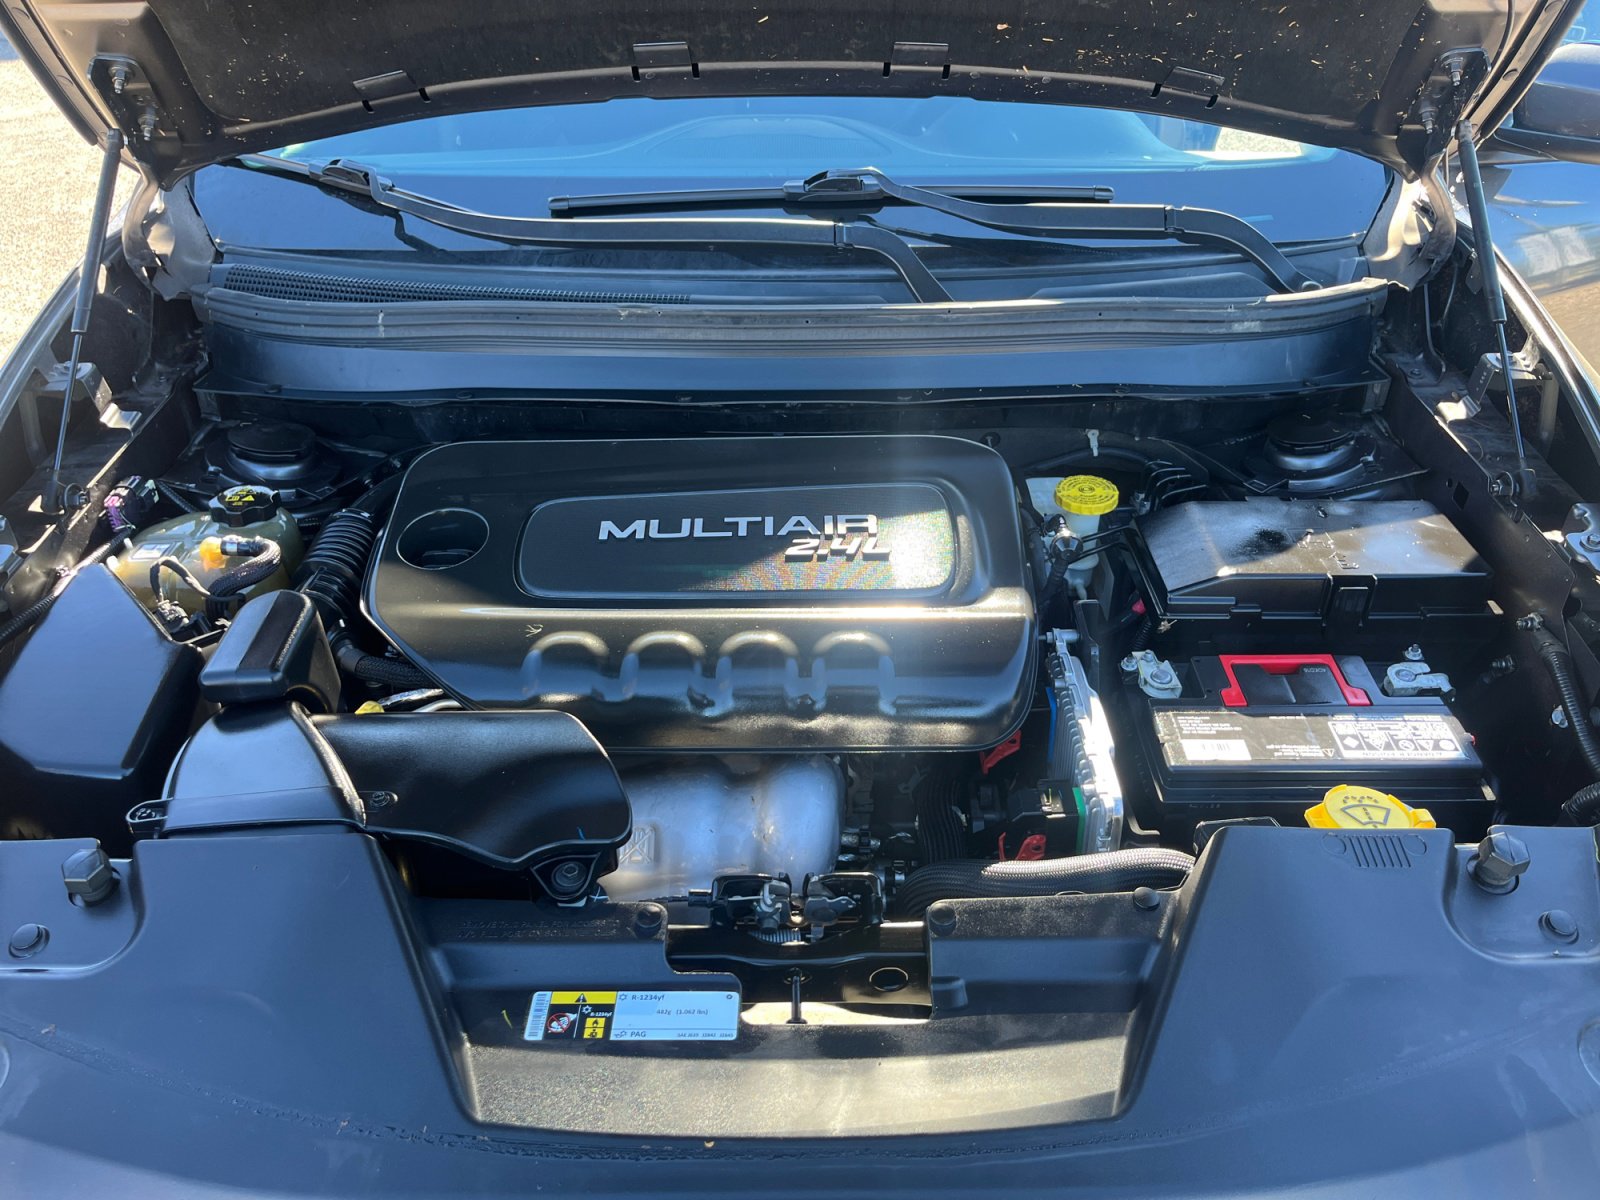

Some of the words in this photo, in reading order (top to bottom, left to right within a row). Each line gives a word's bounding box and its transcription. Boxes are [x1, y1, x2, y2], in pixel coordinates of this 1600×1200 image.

[598, 513, 878, 540] MULTIAIR
[784, 536, 891, 561] 2.4L
[631, 994, 665, 1003] R-1234yf
[630, 1030, 647, 1038] PAG
